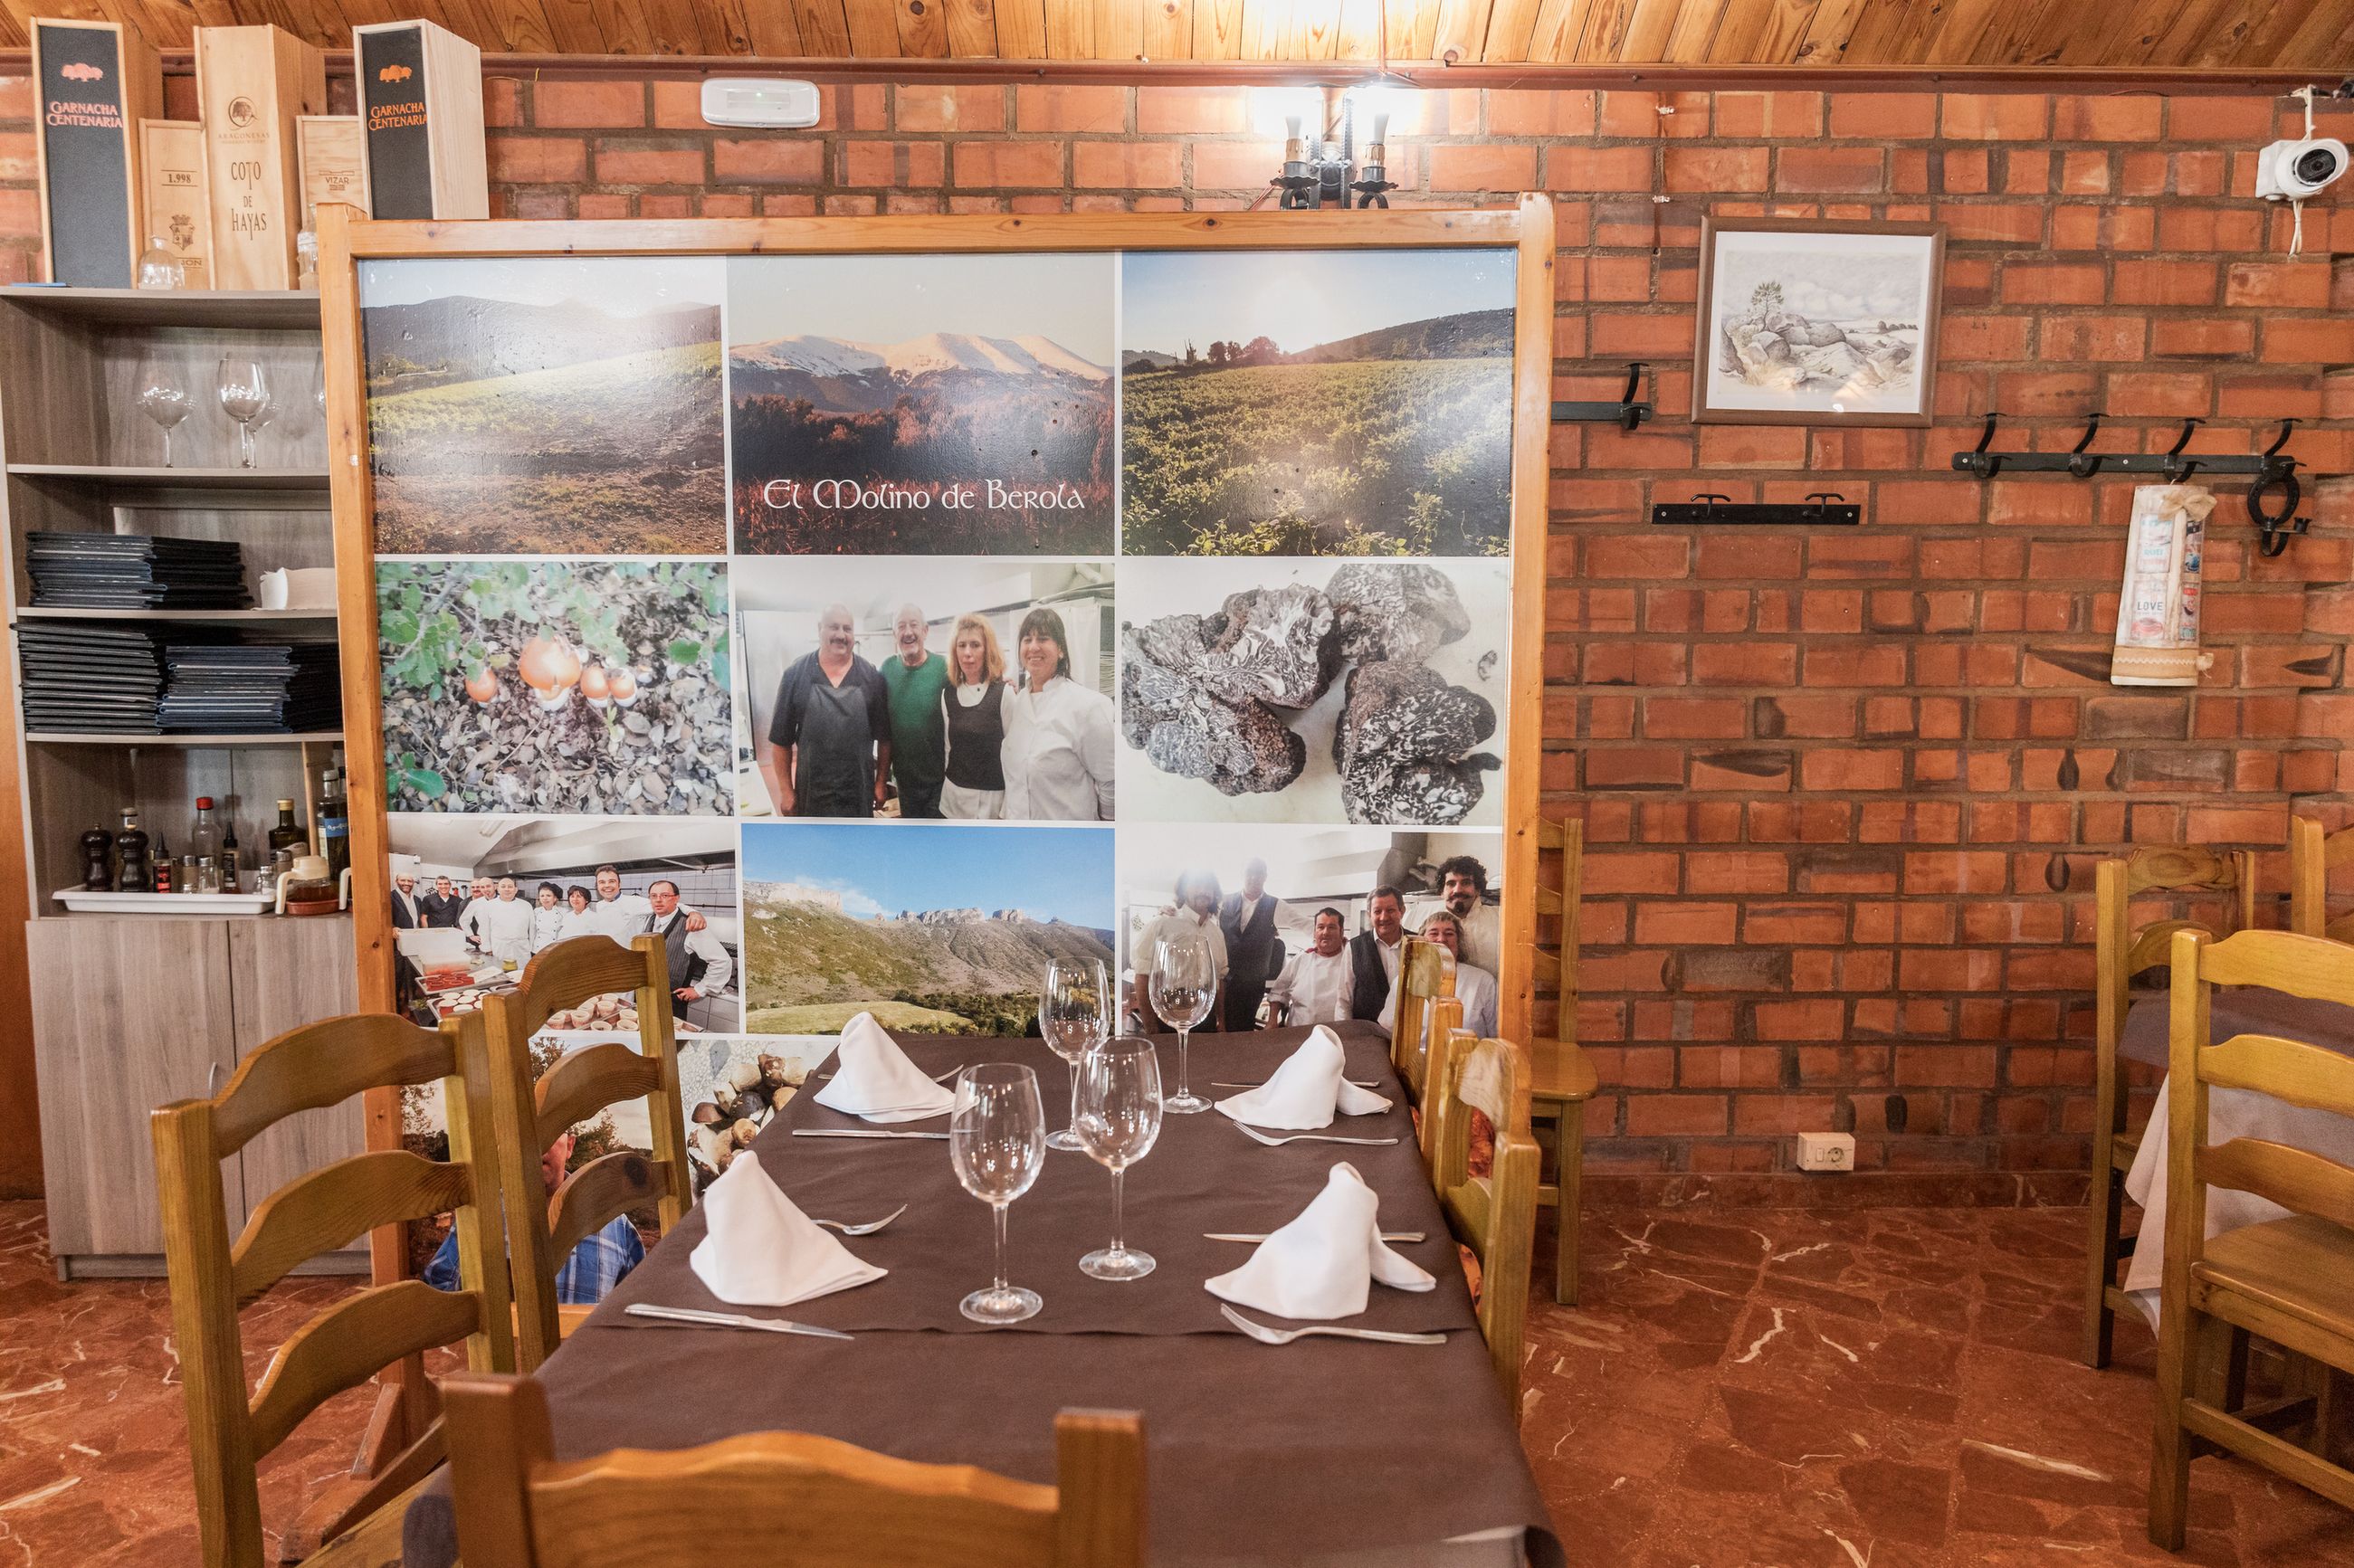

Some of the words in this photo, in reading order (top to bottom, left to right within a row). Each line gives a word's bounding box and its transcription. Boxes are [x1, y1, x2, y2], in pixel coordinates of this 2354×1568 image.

[49, 101, 119, 115] GARNACHA
[370, 102, 425, 119] GARNACHA
[46, 114, 123, 128] CENTENARIA
[368, 114, 427, 131] CENTENARIA
[167, 174, 192, 184] 1.998
[231, 161, 262, 190] COTO
[325, 176, 349, 185] VIZAR
[243, 195, 253, 207] DE
[231, 208, 268, 241] HAYAS
[763, 479, 804, 509] El
[813, 479, 931, 509] Molino
[941, 483, 976, 509] de
[985, 479, 1086, 509] Berola
[2137, 601, 2163, 611] LOVE
